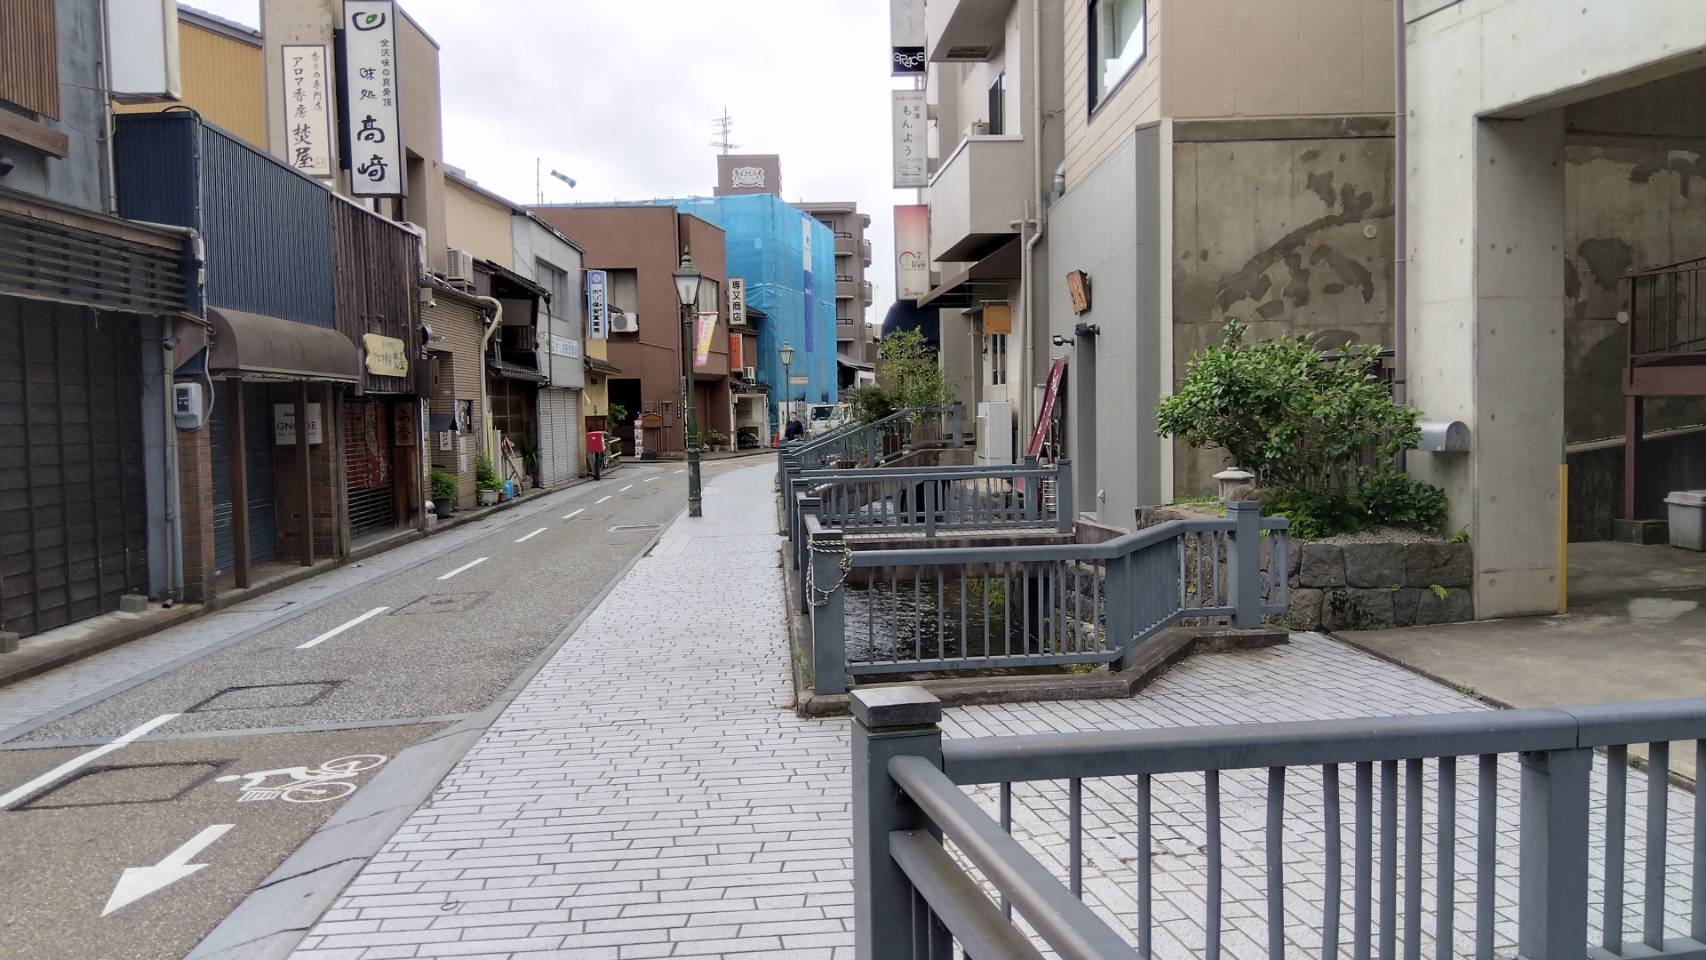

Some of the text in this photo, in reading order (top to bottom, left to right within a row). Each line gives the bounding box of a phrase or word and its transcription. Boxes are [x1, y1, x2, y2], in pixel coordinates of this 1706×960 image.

[311, 51, 322, 111] 香りの専門店
[380, 38, 392, 107] 金沢味の真骨頂
[893, 51, 925, 68] GRACE
[902, 104, 913, 157] もんよう
[276, 421, 317, 431] GNE
